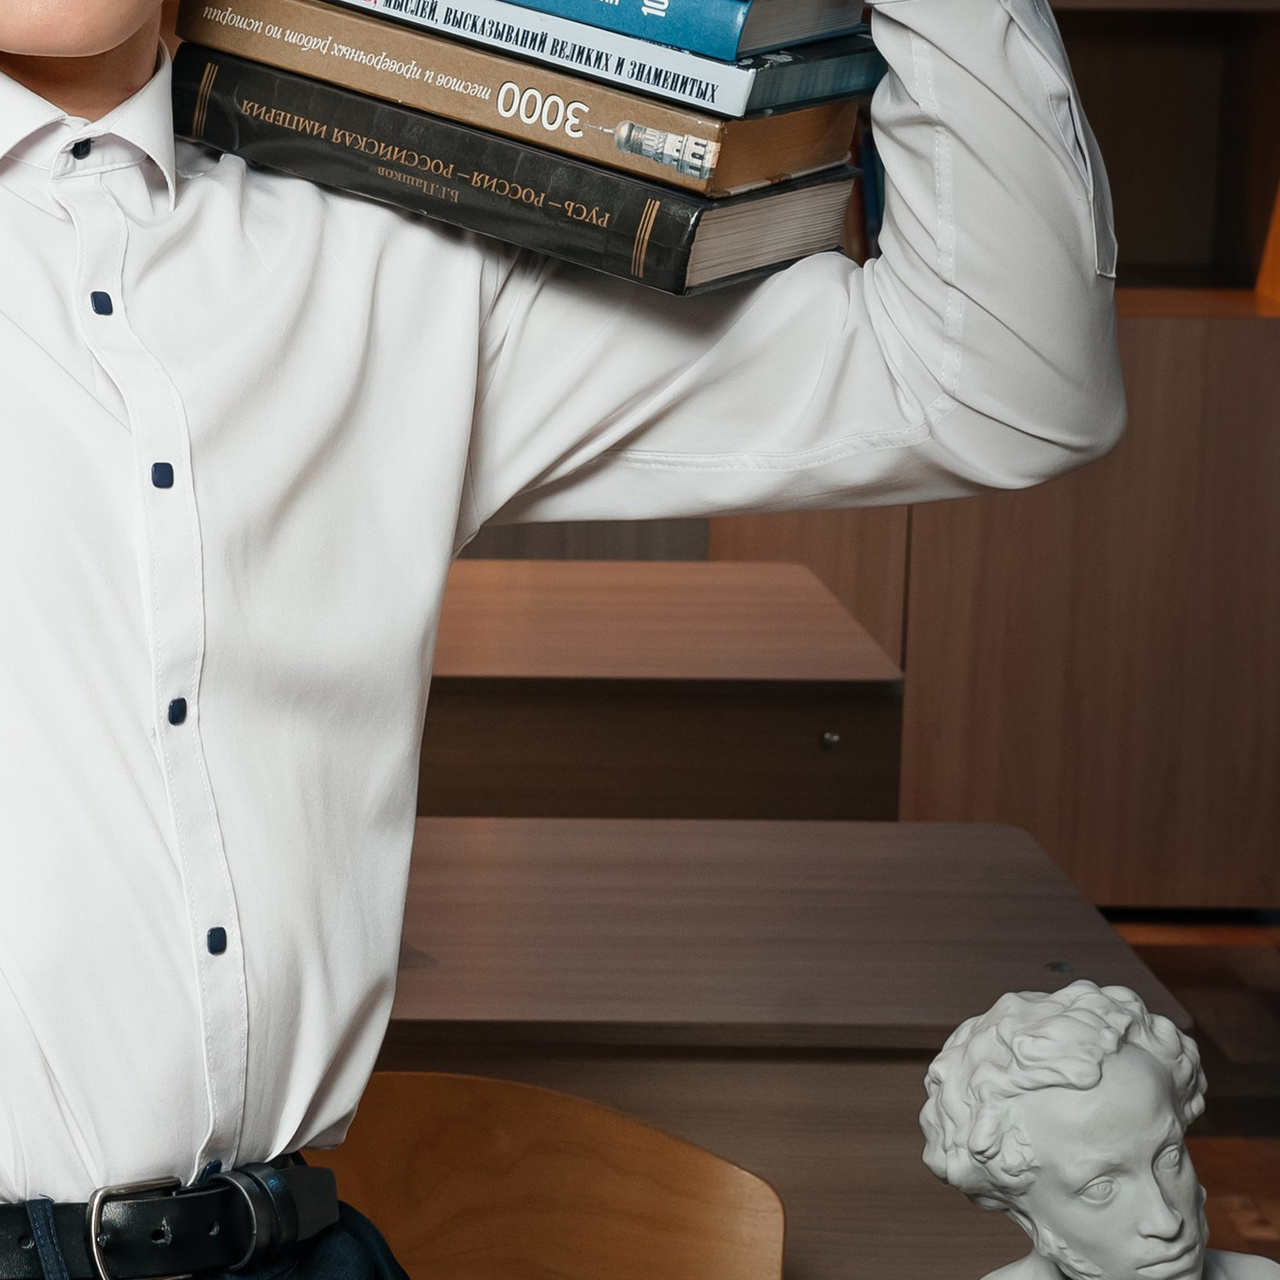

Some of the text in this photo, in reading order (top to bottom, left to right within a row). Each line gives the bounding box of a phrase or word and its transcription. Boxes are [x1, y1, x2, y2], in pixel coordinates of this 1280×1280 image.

[202, 6, 590, 138] 3000 тестов и проверочных работ по истории
[444, 6, 549, 54] ВЫСКАЗЫВАНИЙ
[549, 38, 613, 72] ВЕЛИКИХ
[615, 56, 625, 76] И
[627, 59, 719, 104] ЗНАМЕНИТЫХ
[241, 99, 328, 140] ИМПЕРИЯ
[331, 127, 455, 179] РОССИЙСКАЯ
[471, 171, 546, 208] РОССИЯ
[564, 200, 610, 228] РУСЬ
